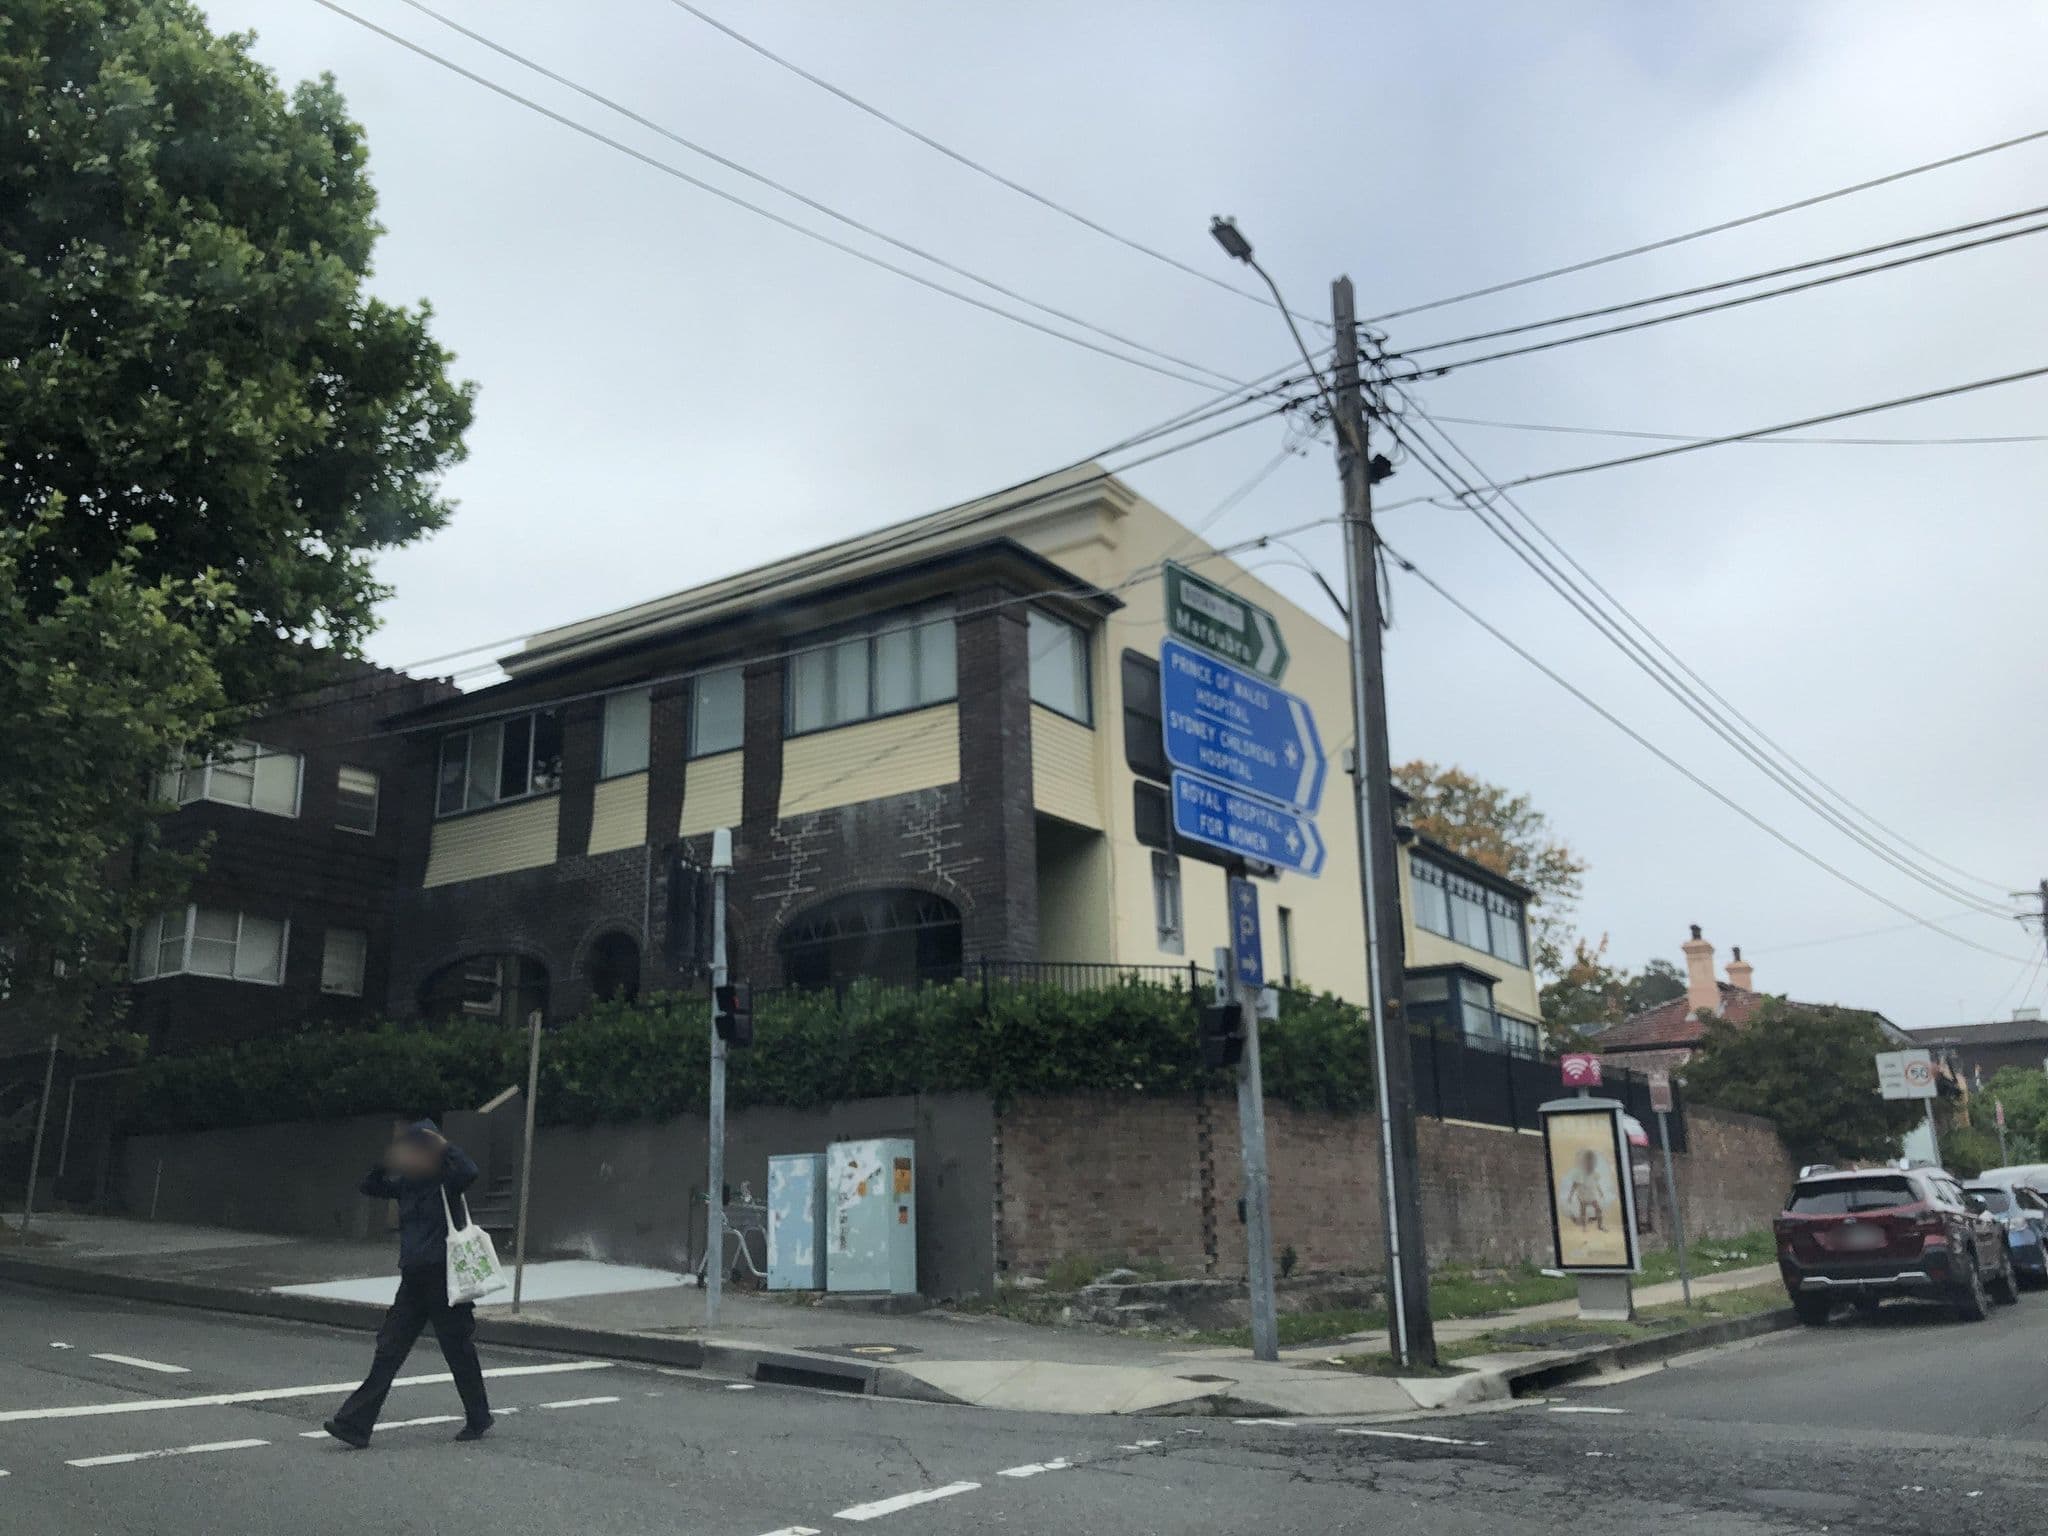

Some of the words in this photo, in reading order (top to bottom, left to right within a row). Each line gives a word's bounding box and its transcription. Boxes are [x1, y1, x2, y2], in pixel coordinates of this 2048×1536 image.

[1171, 653, 1211, 685] PRINCE
[1216, 672, 1229, 690] OF
[1234, 681, 1270, 710] WALES
[1195, 688, 1249, 724] HOSPITAL
[1170, 711, 1216, 742] SYDNEY
[1200, 747, 1252, 781] HOSPITAL
[1180, 780, 1222, 812] ROYAL
[1227, 799, 1281, 833] HOSPITAL
[1200, 814, 1223, 837] FOR
[1228, 824, 1267, 852] WOMEN
